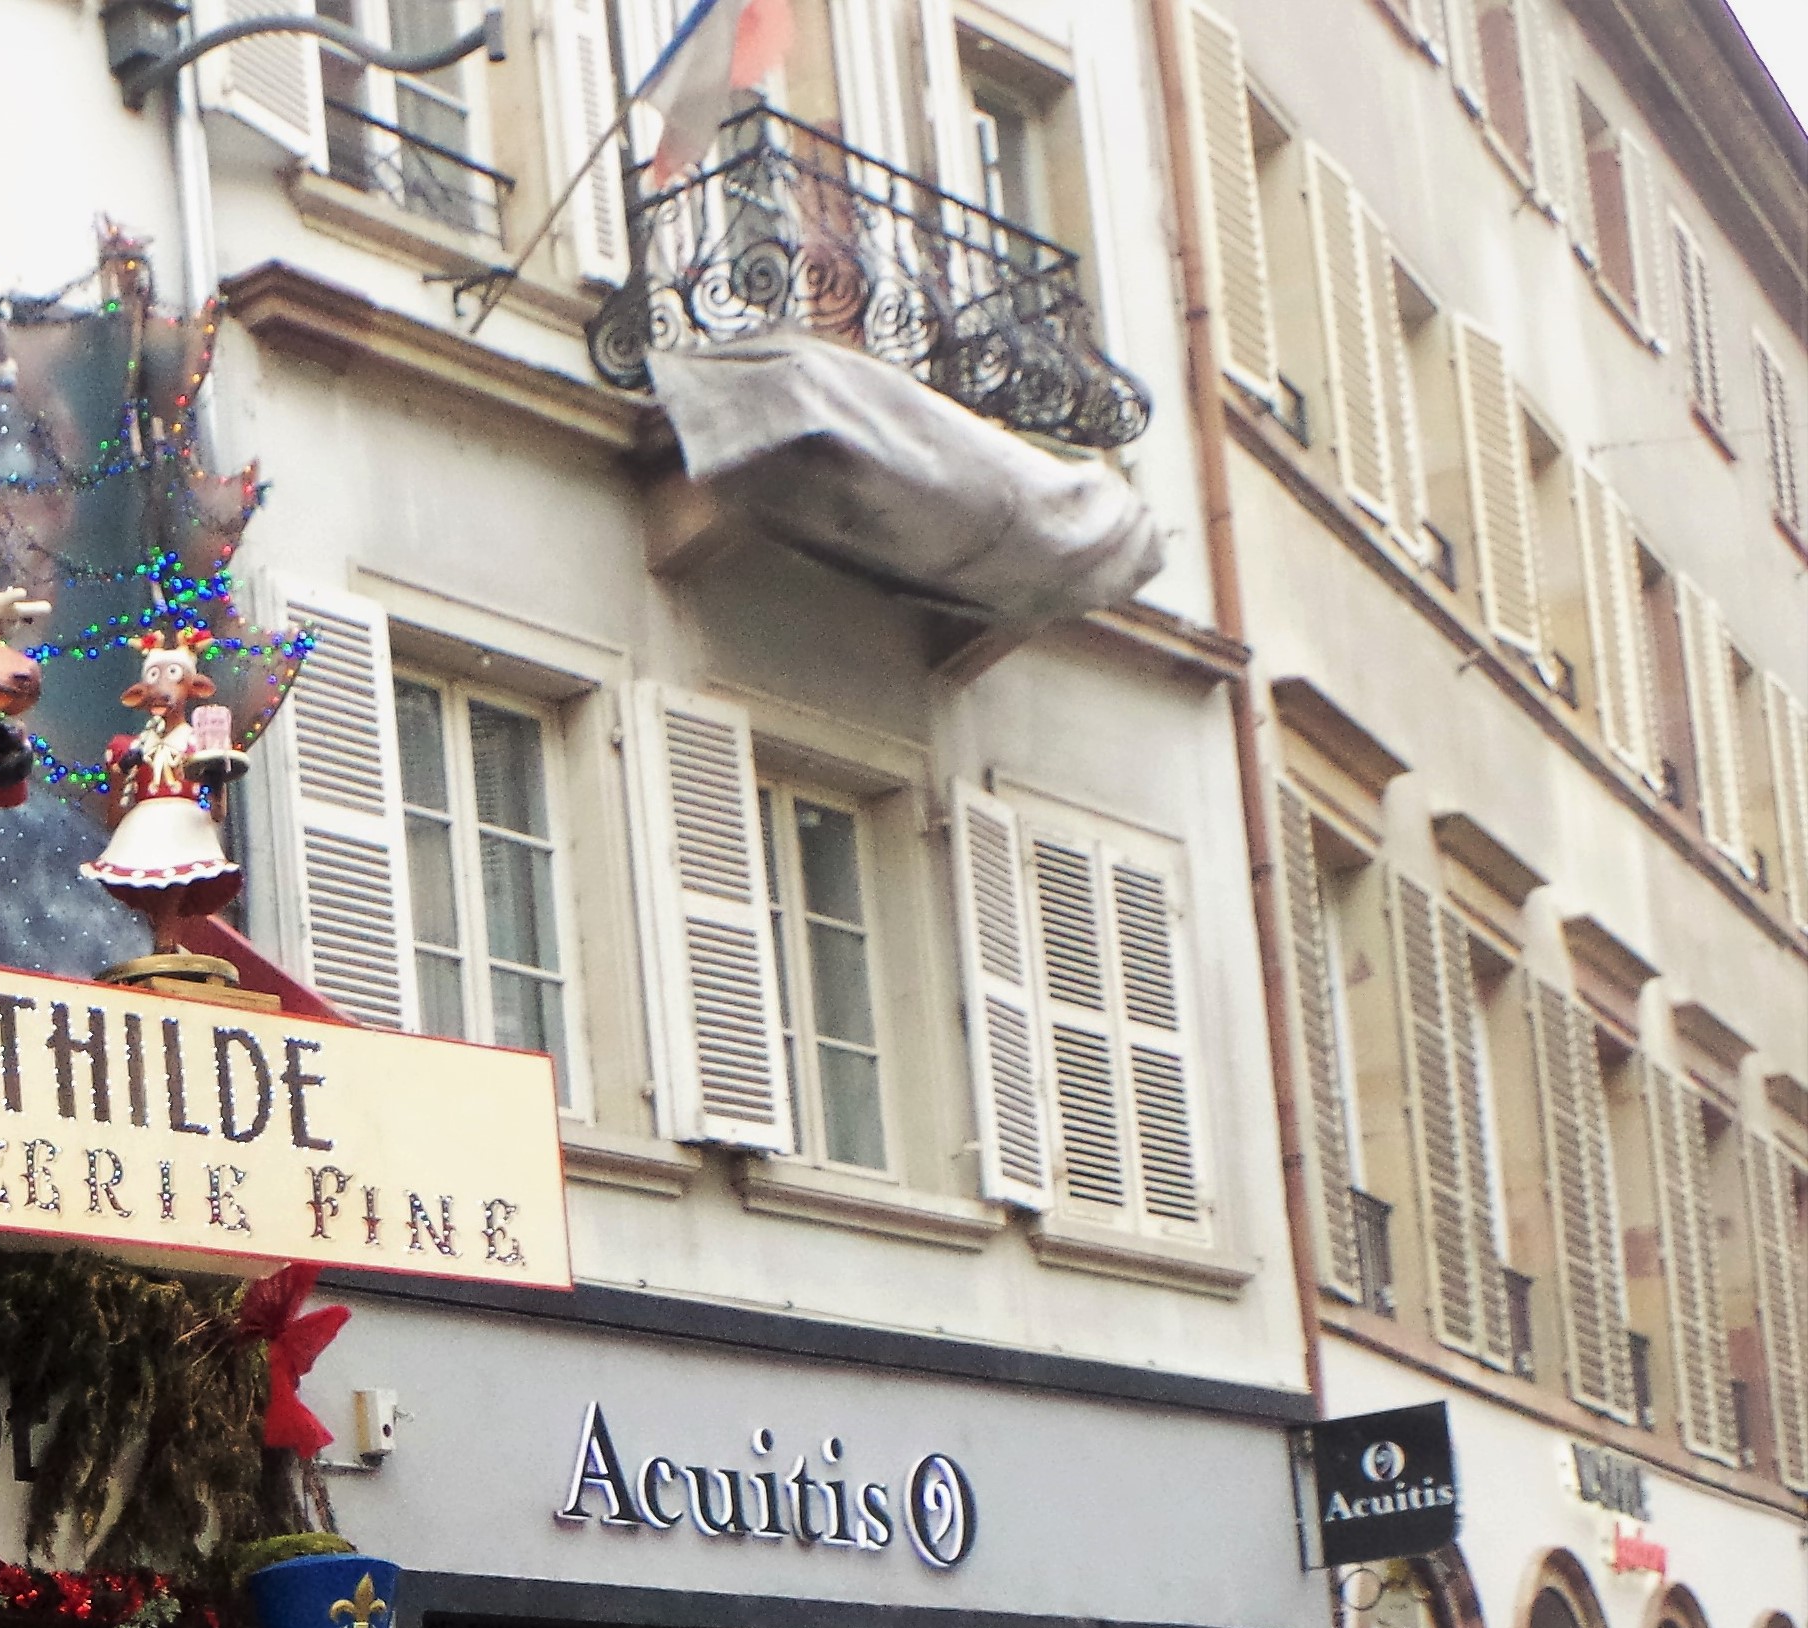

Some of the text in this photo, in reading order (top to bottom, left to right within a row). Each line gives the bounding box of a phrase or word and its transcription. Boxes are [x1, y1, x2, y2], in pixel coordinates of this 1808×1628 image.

[306, 1165, 526, 1267] FINE
[554, 1400, 894, 1551] Acuitis
[1323, 1476, 1454, 1523] Acuitis
